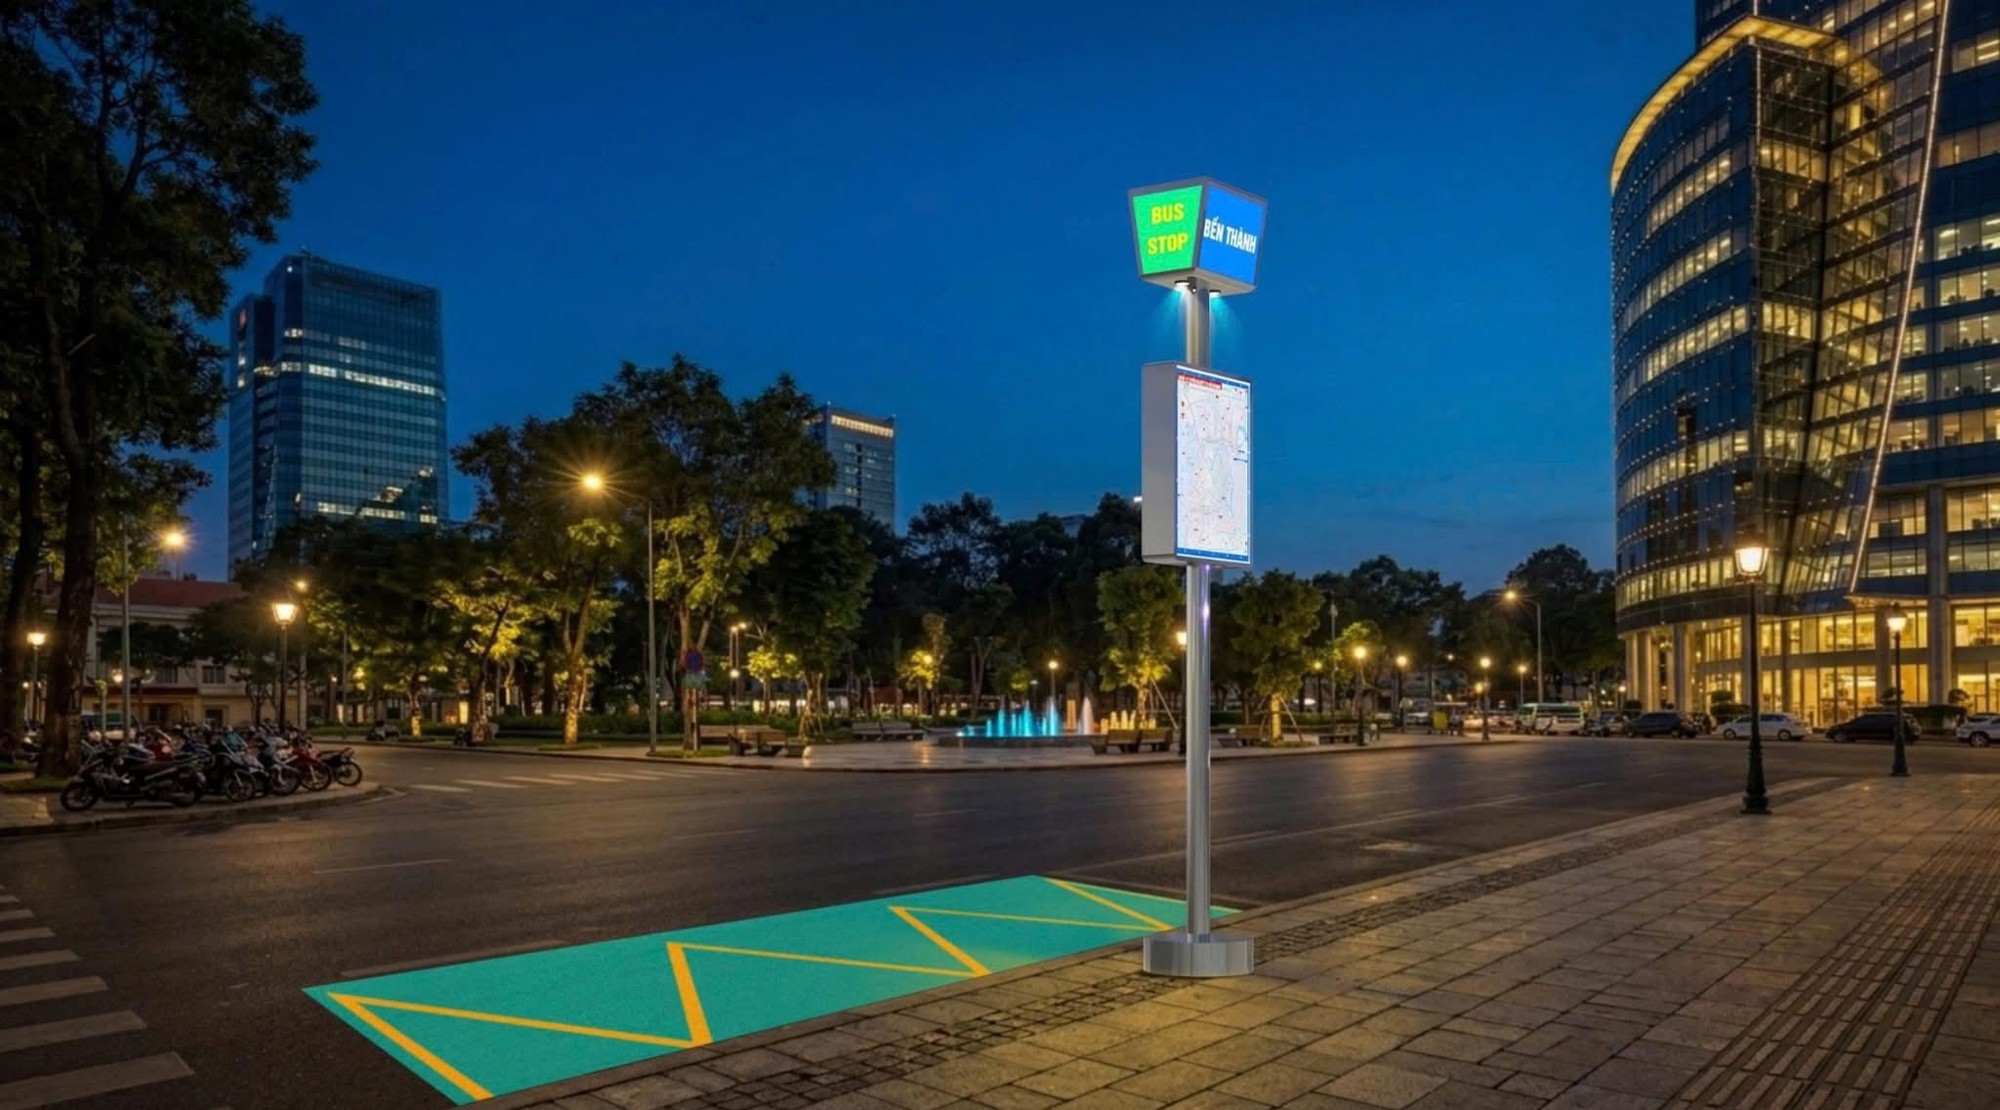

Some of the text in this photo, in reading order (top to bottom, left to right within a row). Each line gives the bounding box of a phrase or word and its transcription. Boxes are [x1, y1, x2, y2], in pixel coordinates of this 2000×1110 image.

[1151, 203, 1184, 224] BUS
[1147, 233, 1188, 255] STOP
[1203, 217, 1257, 254] BẾN THÀNH
